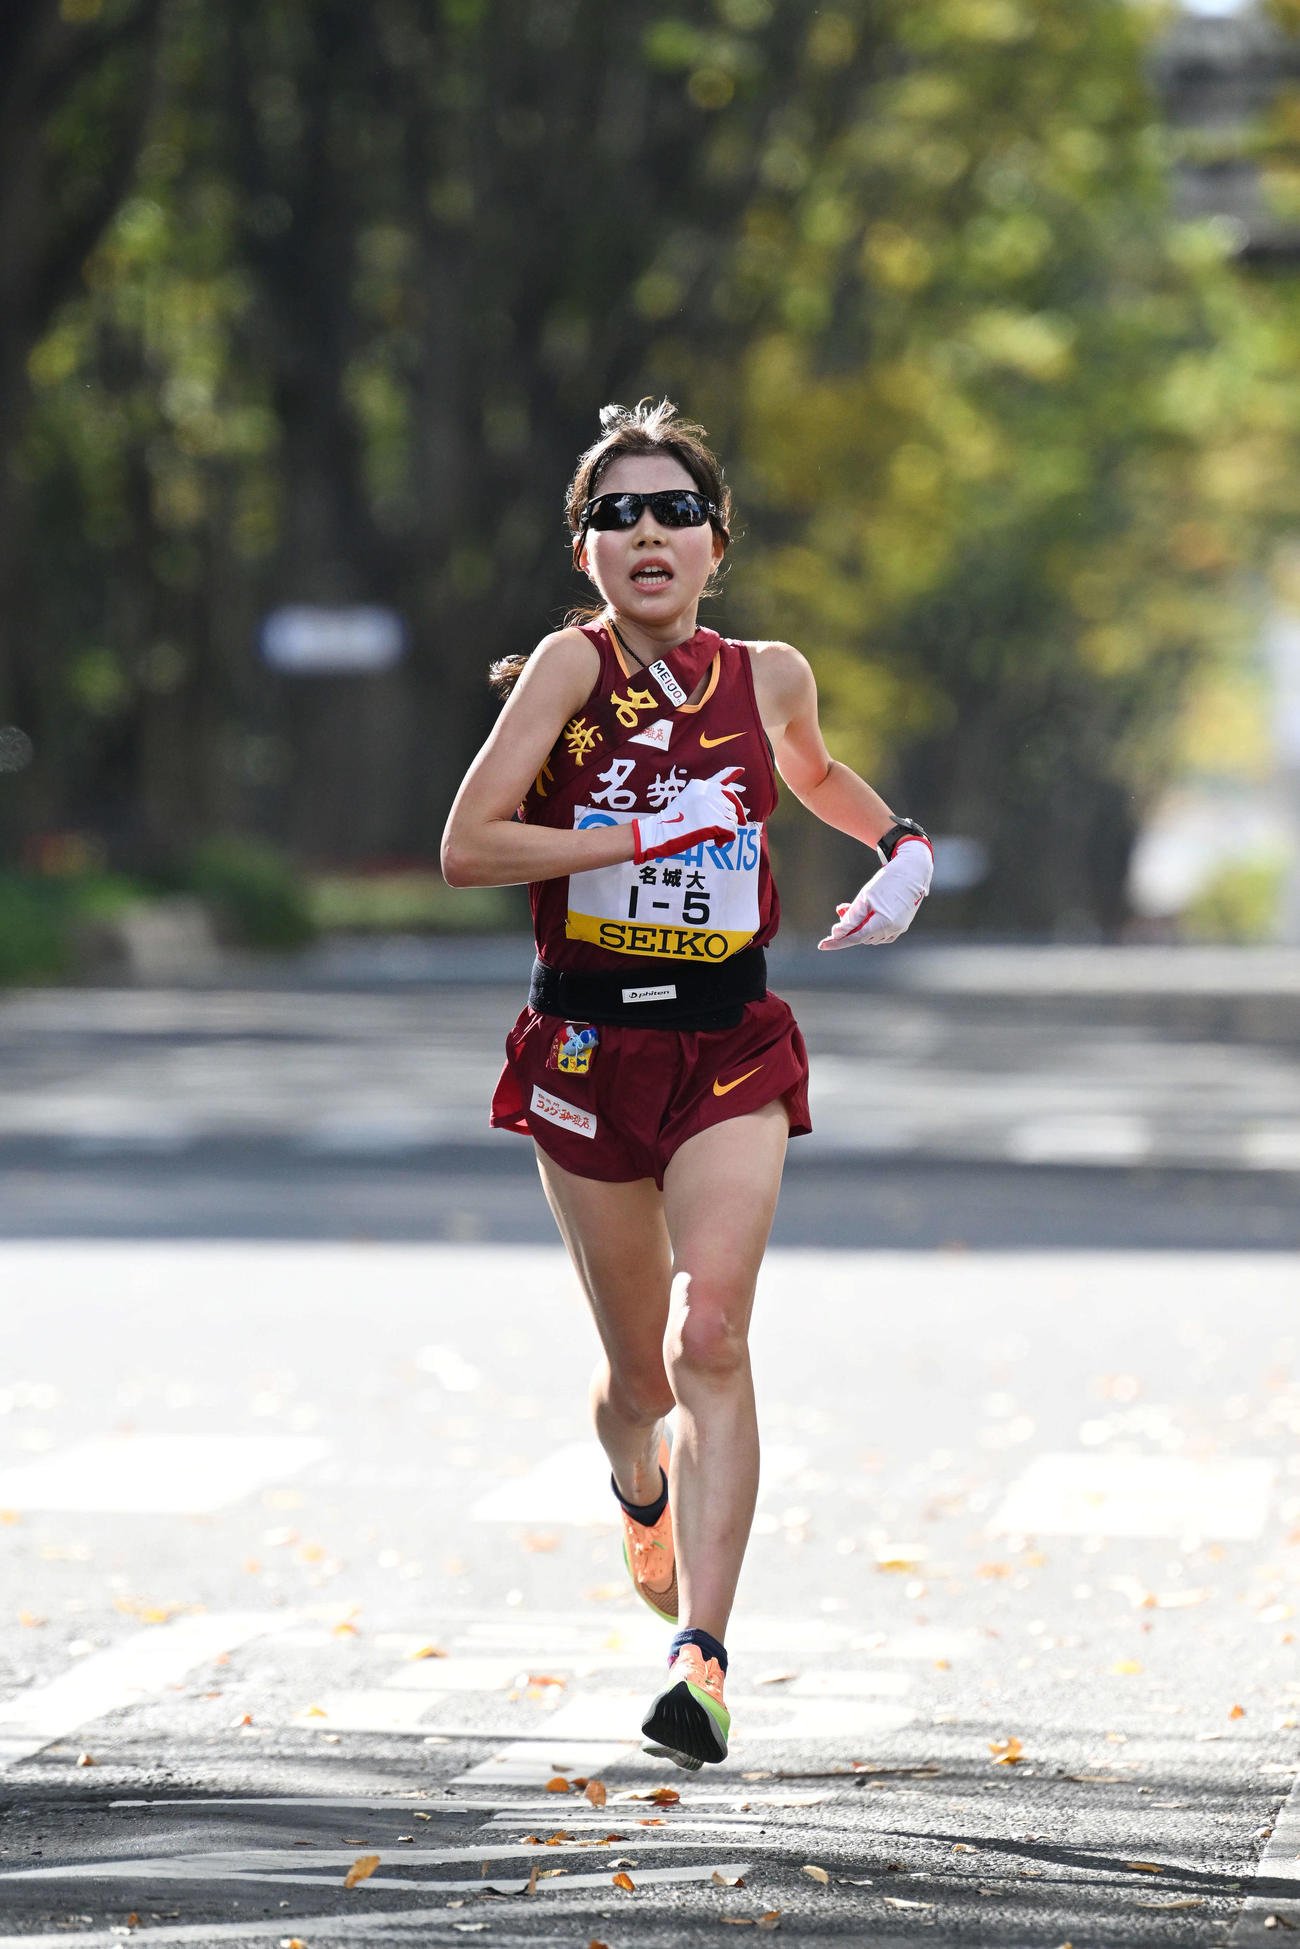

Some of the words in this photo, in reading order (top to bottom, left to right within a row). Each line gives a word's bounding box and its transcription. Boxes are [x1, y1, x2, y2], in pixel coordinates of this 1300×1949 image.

[589, 758, 748, 815] 名城
[638, 865, 706, 890] 名城大
[600, 923, 728, 959] SEIKO
